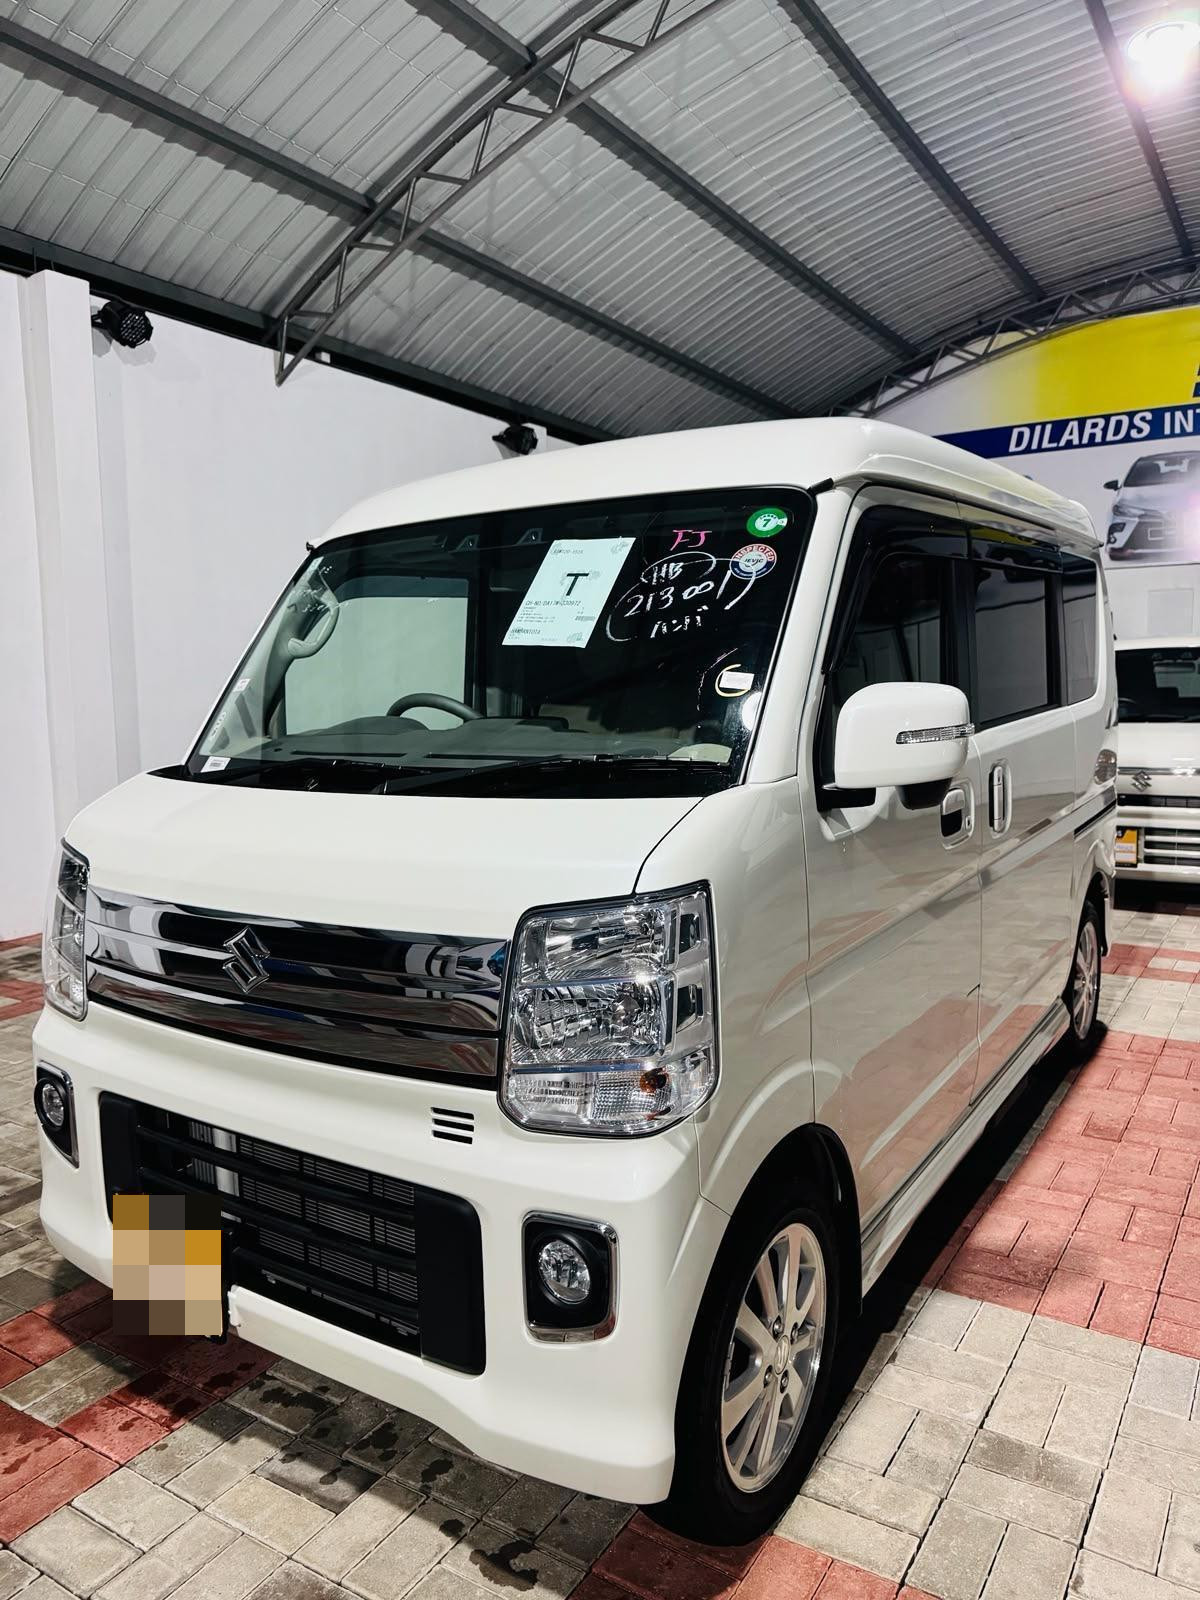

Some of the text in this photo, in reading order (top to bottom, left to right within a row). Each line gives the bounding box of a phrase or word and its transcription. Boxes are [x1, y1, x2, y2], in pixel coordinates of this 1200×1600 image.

[1008, 408, 1200, 453] DILARDS IN
[762, 518, 772, 528] 7
[733, 544, 775, 562] INSPECTED
[566, 572, 590, 597] T
